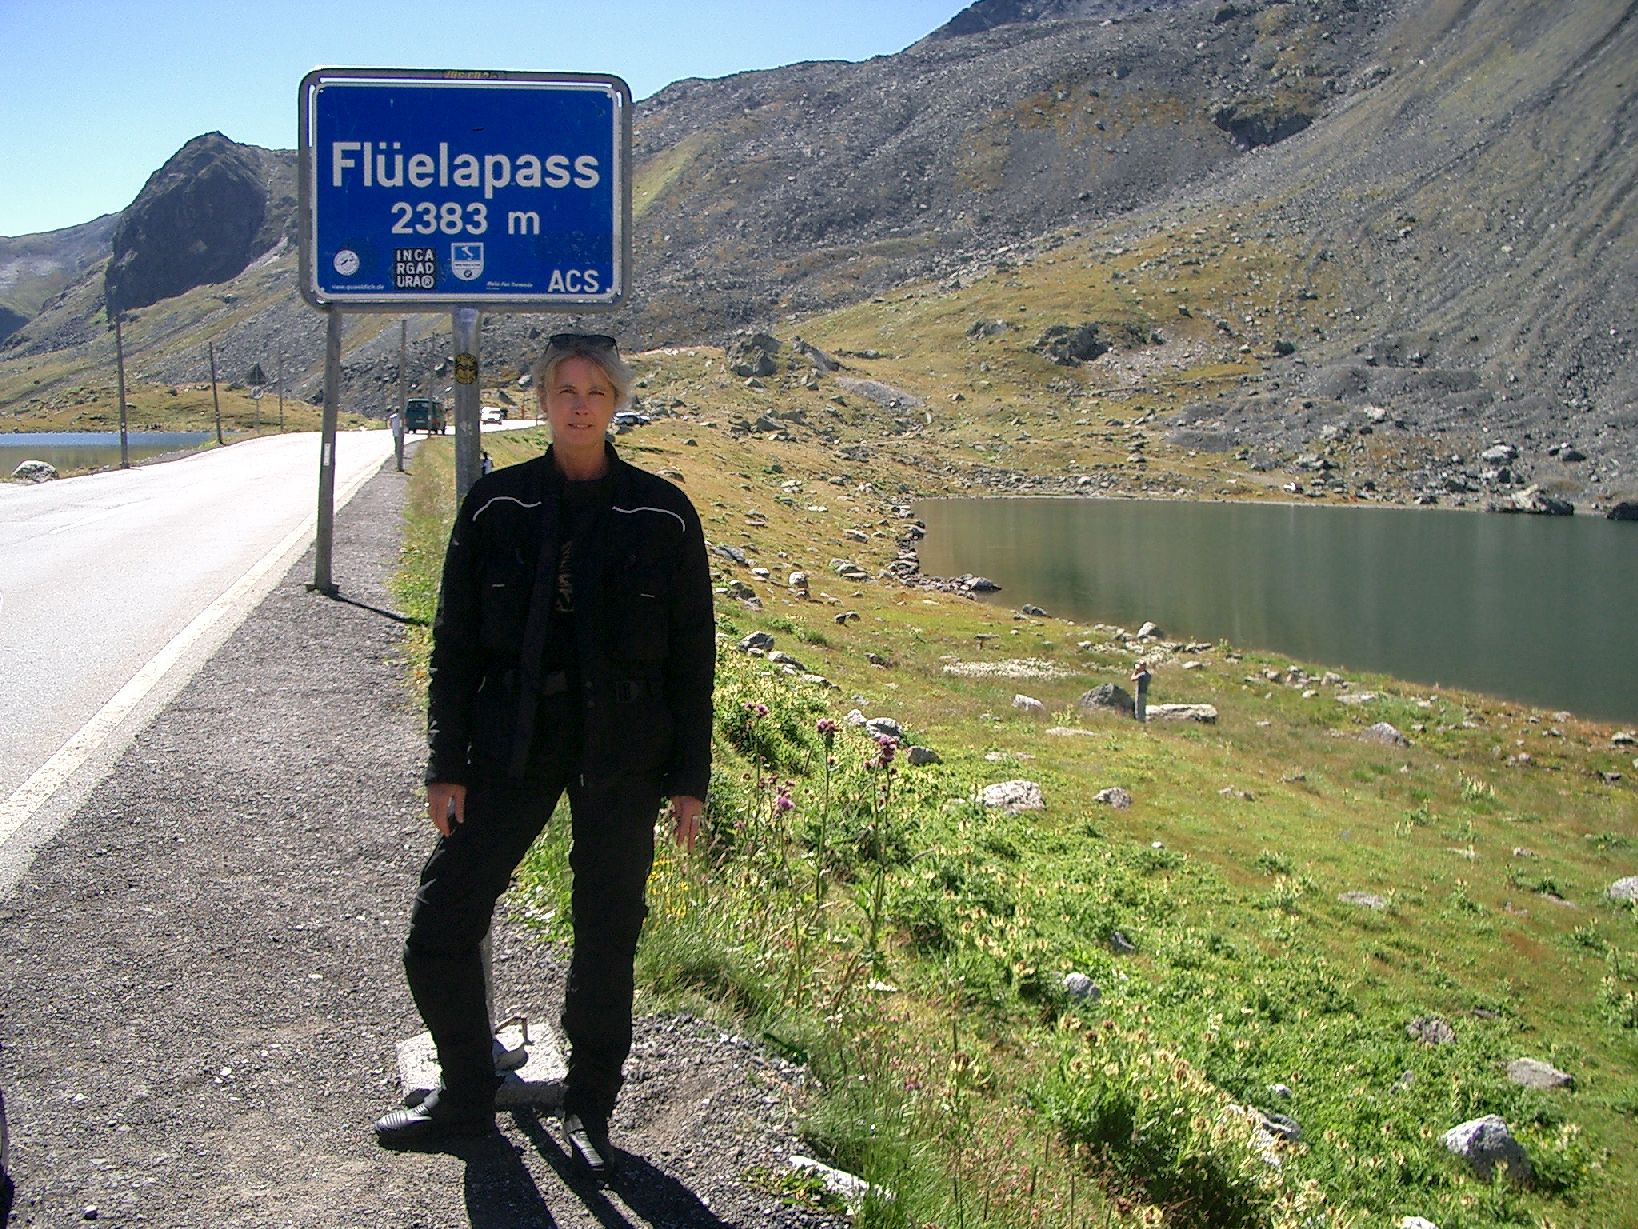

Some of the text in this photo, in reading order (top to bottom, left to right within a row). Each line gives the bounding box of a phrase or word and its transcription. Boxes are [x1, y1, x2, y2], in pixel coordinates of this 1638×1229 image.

[332, 141, 600, 199] Flüelapass
[391, 202, 540, 235] 2383 m
[396, 248, 434, 261] INCA
[396, 262, 434, 275] RGAD
[547, 269, 599, 293] ACS
